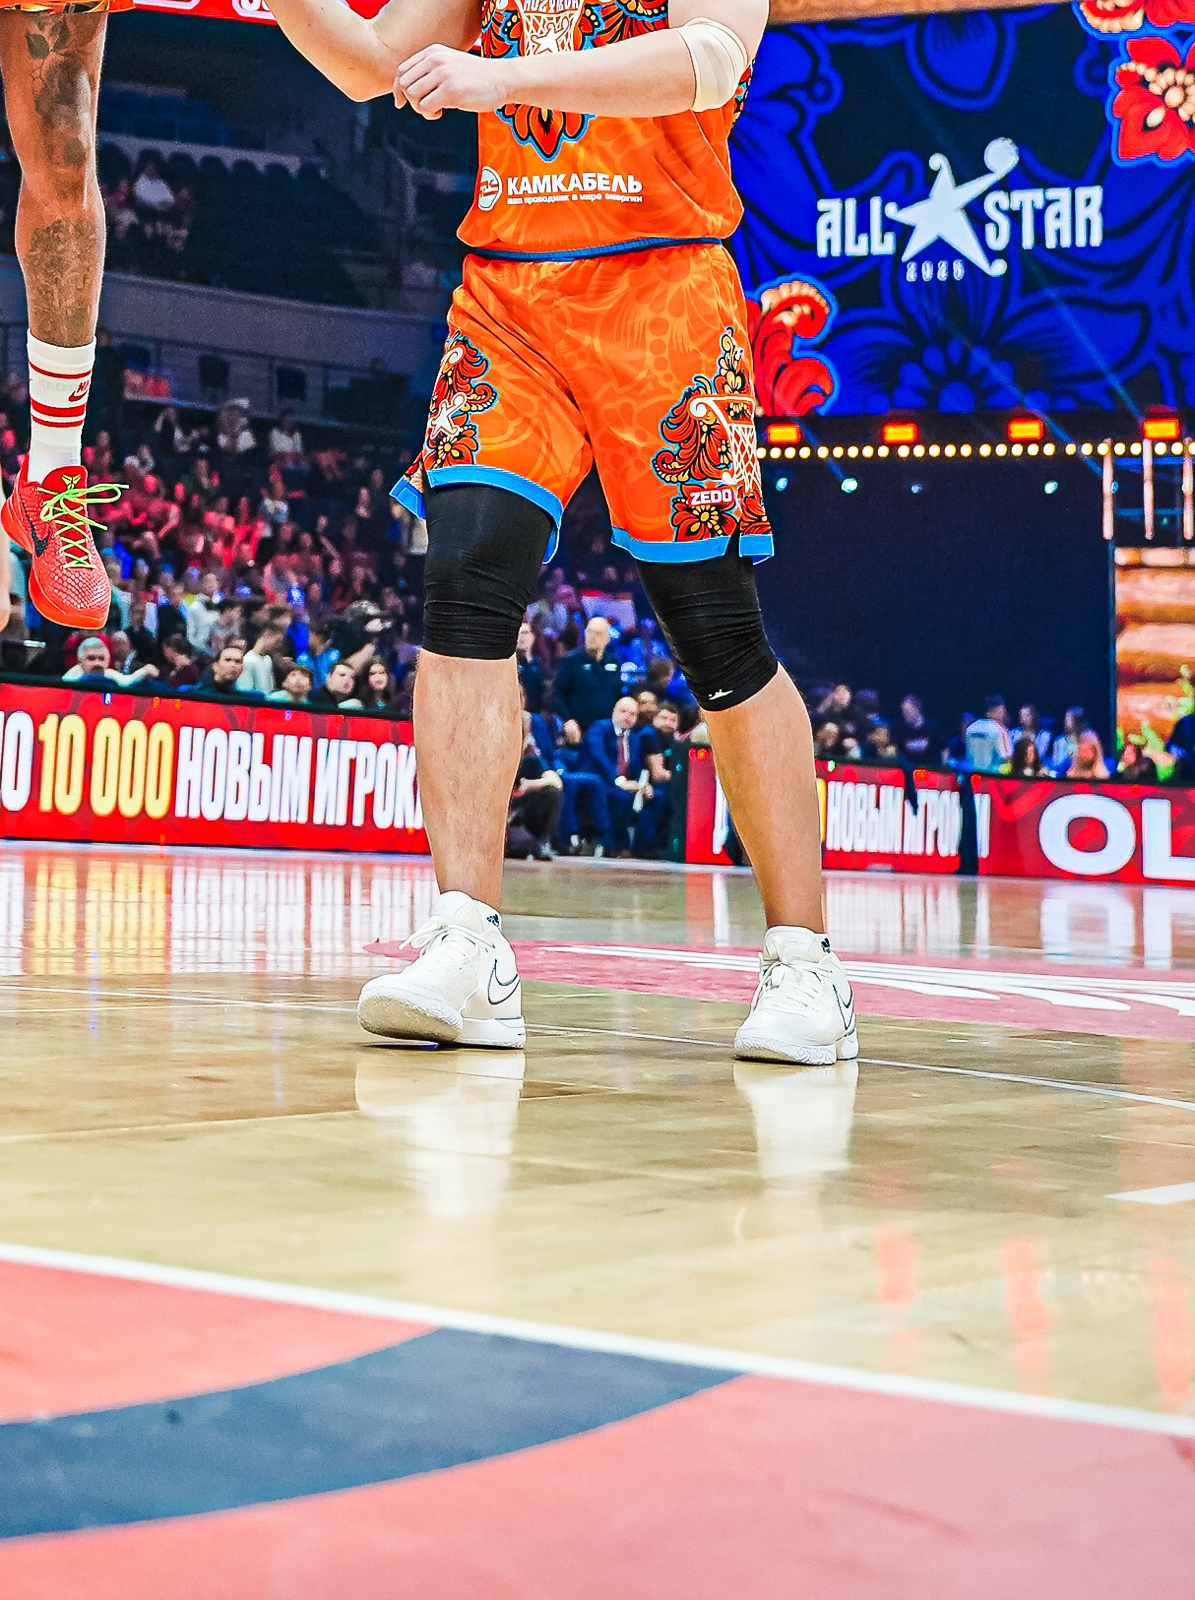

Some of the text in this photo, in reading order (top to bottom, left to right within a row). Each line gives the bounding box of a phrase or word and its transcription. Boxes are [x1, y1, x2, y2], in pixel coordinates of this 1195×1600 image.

[507, 172, 643, 196] КАМКАБЕЛЬ
[816, 185, 1104, 258] ALL STAR
[690, 489, 732, 505] ZEDO
[39, 713, 86, 816] 10
[91, 717, 173, 820] 000
[175, 725, 312, 824] НОВЫМ
